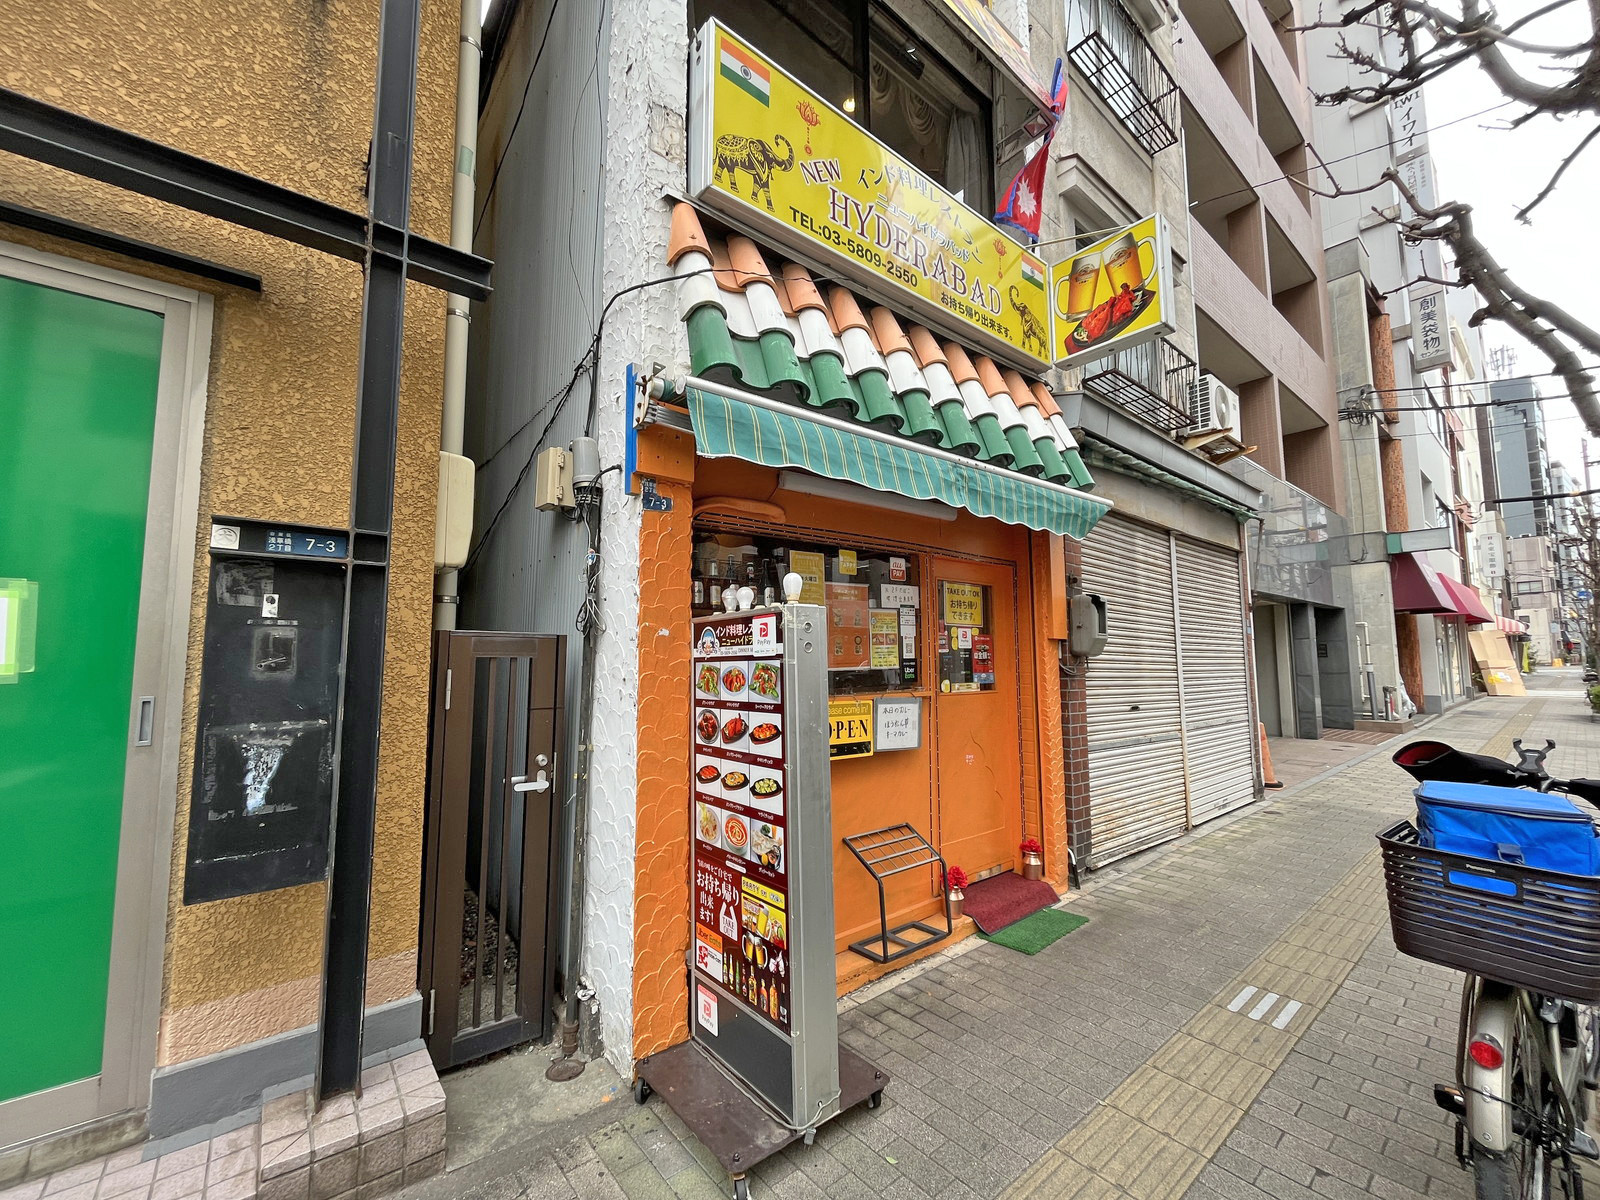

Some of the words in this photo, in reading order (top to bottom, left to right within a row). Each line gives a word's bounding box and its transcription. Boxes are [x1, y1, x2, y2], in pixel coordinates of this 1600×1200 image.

[1399, 106, 1417, 147] イワイ
[800, 159, 841, 184] NEW
[789, 205, 918, 288] TEL:03-5809-2550
[828, 185, 1002, 316] HYDERABAD
[940, 291, 1013, 341] お持ち帰り出来ます。
[1419, 296, 1441, 350] 創美袋物
[649, 497, 667, 510] 7-3
[305, 538, 336, 553] 7-3
[892, 569, 904, 577] PAY
[946, 587, 960, 596] TAKE
[961, 588, 972, 597] OUT
[972, 589, 980, 598] OK
[949, 599, 978, 610] お持ち帰り
[843, 705, 860, 714] come
[696, 869, 739, 907] お持ち帰り
[722, 916, 735, 931] TAKE
[723, 925, 733, 938] OUT
